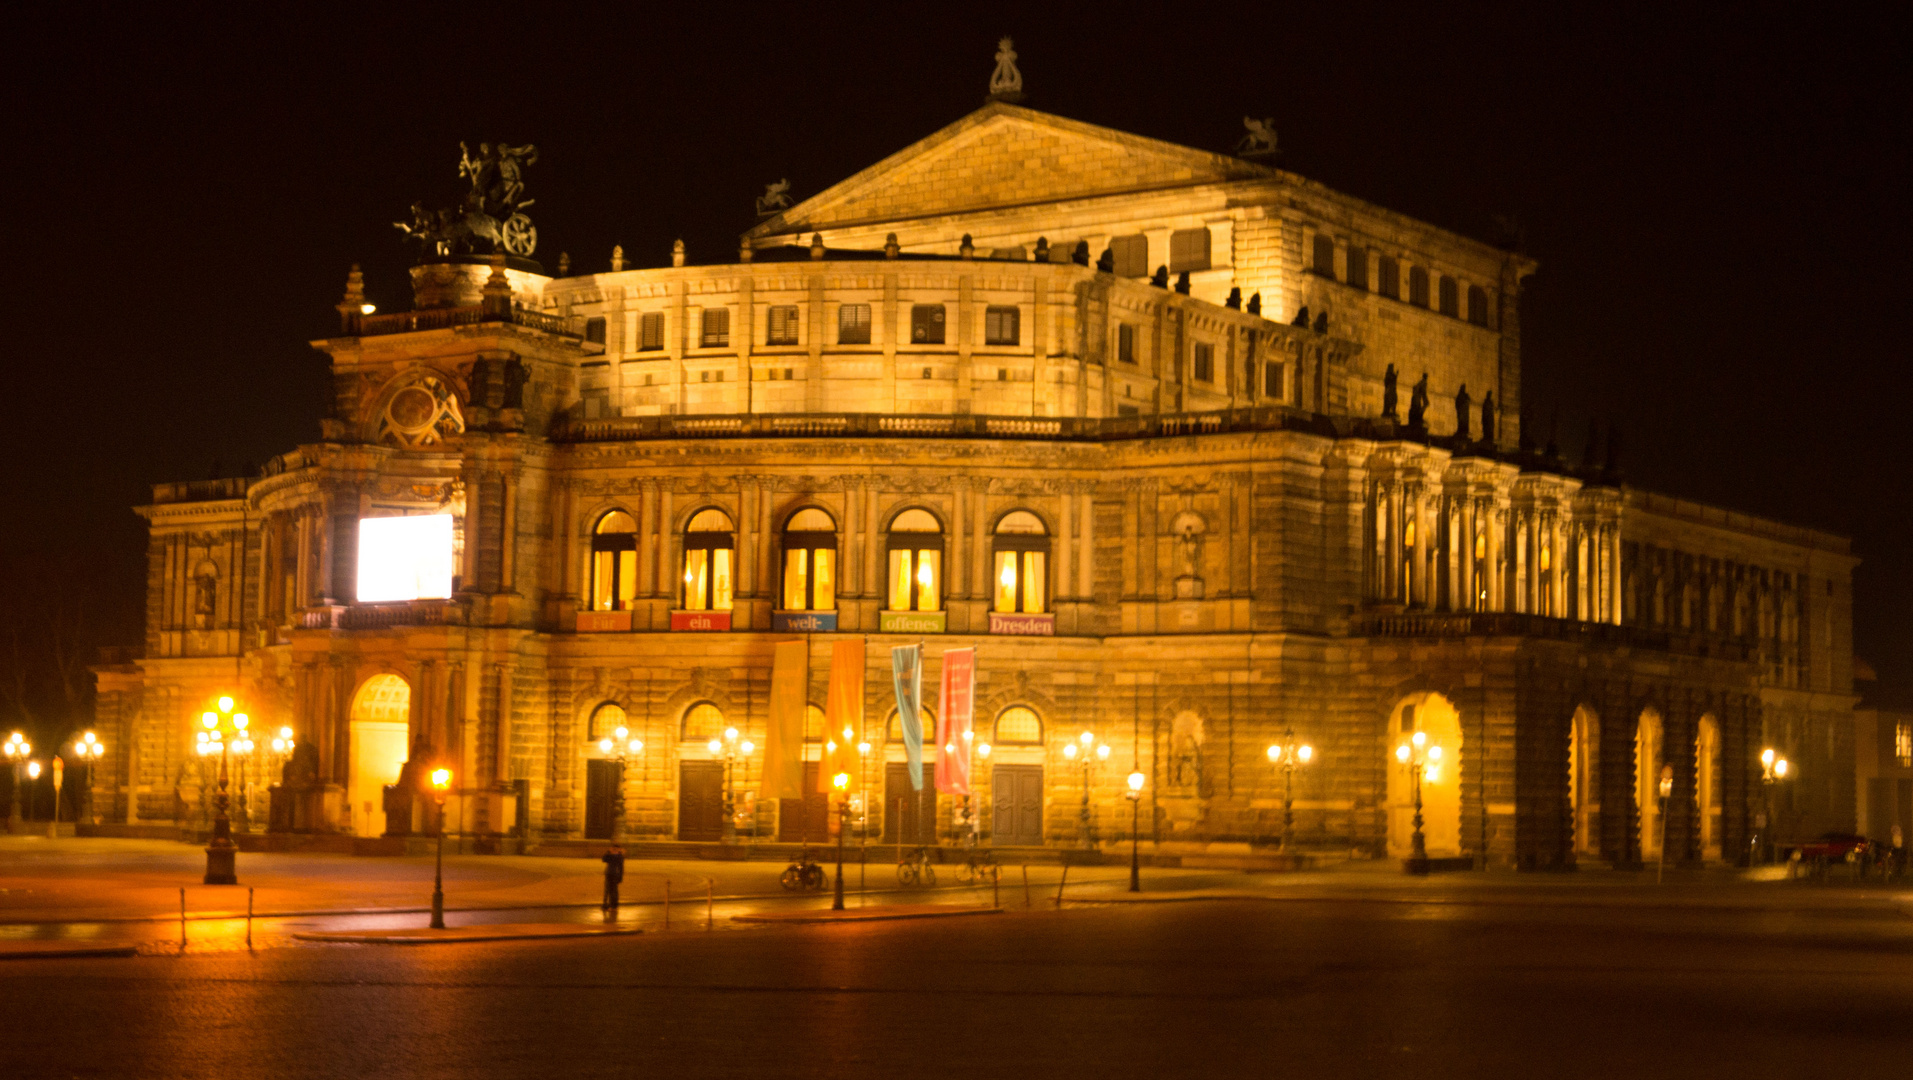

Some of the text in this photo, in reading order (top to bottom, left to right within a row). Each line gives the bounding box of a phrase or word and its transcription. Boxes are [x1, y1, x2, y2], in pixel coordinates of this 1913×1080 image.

[689, 615, 712, 629] ein
[787, 615, 822, 630] welt-
[886, 616, 939, 631] offenes
[992, 618, 1052, 633] Dresden
